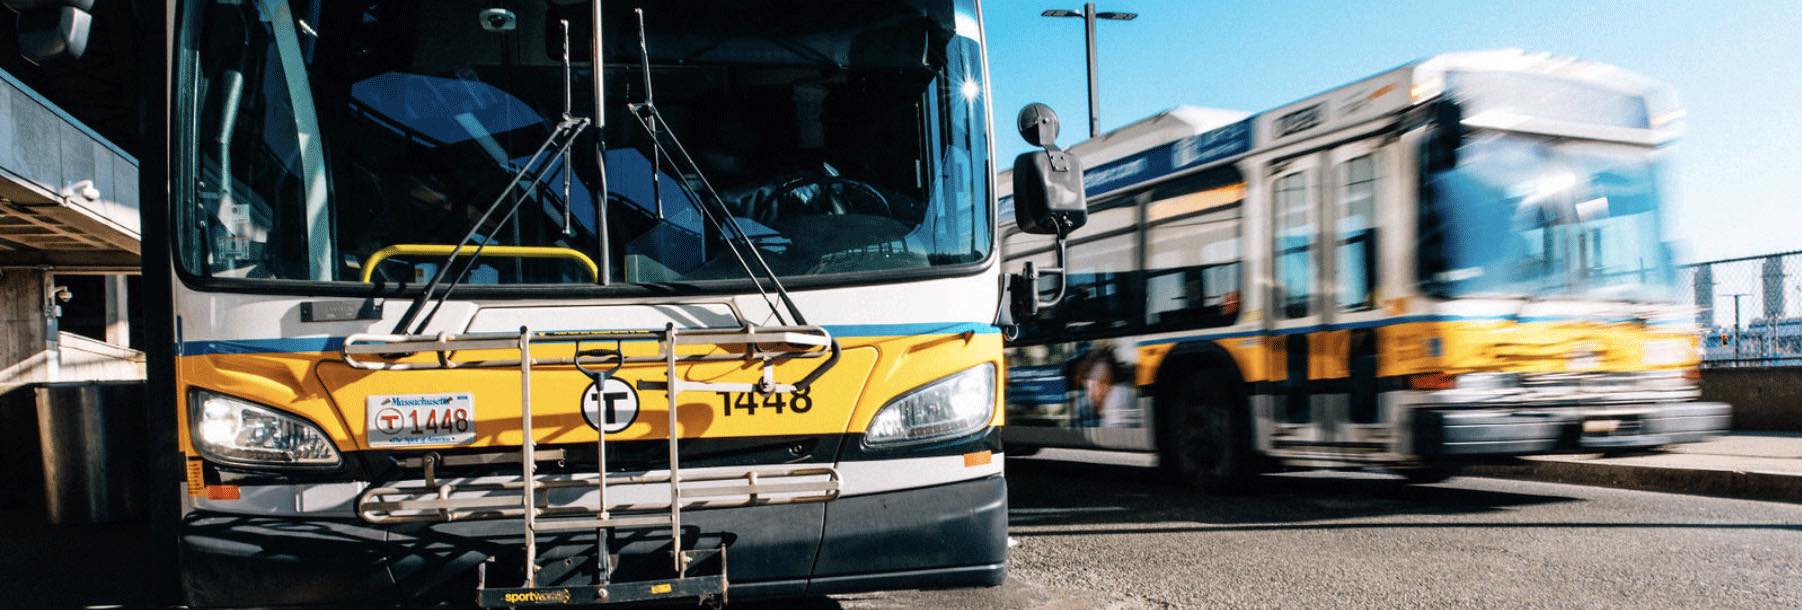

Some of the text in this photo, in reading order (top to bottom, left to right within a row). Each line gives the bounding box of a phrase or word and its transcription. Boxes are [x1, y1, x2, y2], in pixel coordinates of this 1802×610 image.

[391, 397, 450, 406] Massachuset
[591, 391, 628, 424] T
[716, 387, 813, 416] 1448
[380, 408, 469, 434] T 1448
[504, 592, 563, 603] sportwor
